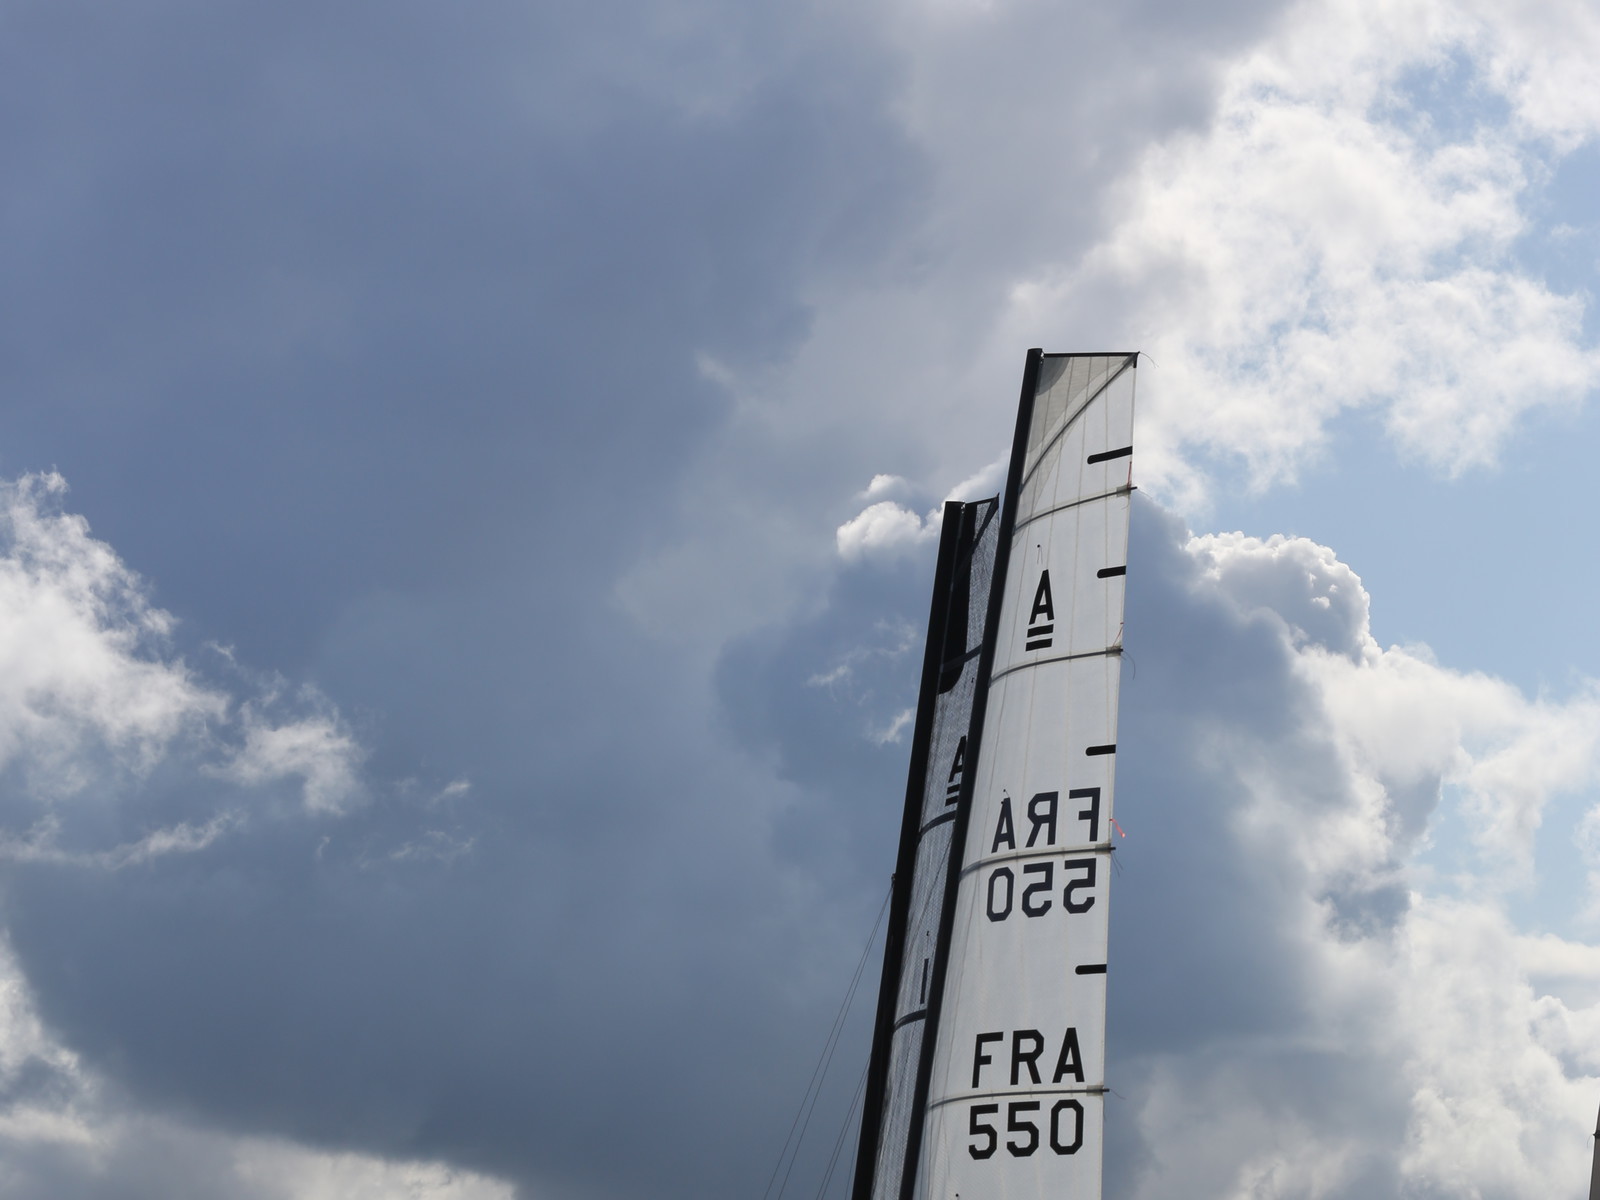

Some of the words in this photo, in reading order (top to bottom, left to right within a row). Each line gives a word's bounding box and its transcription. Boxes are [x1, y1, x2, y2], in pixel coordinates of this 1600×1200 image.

[1028, 568, 1055, 625] A
[971, 1027, 1085, 1089] FRA
[968, 1098, 1085, 1161] 550
